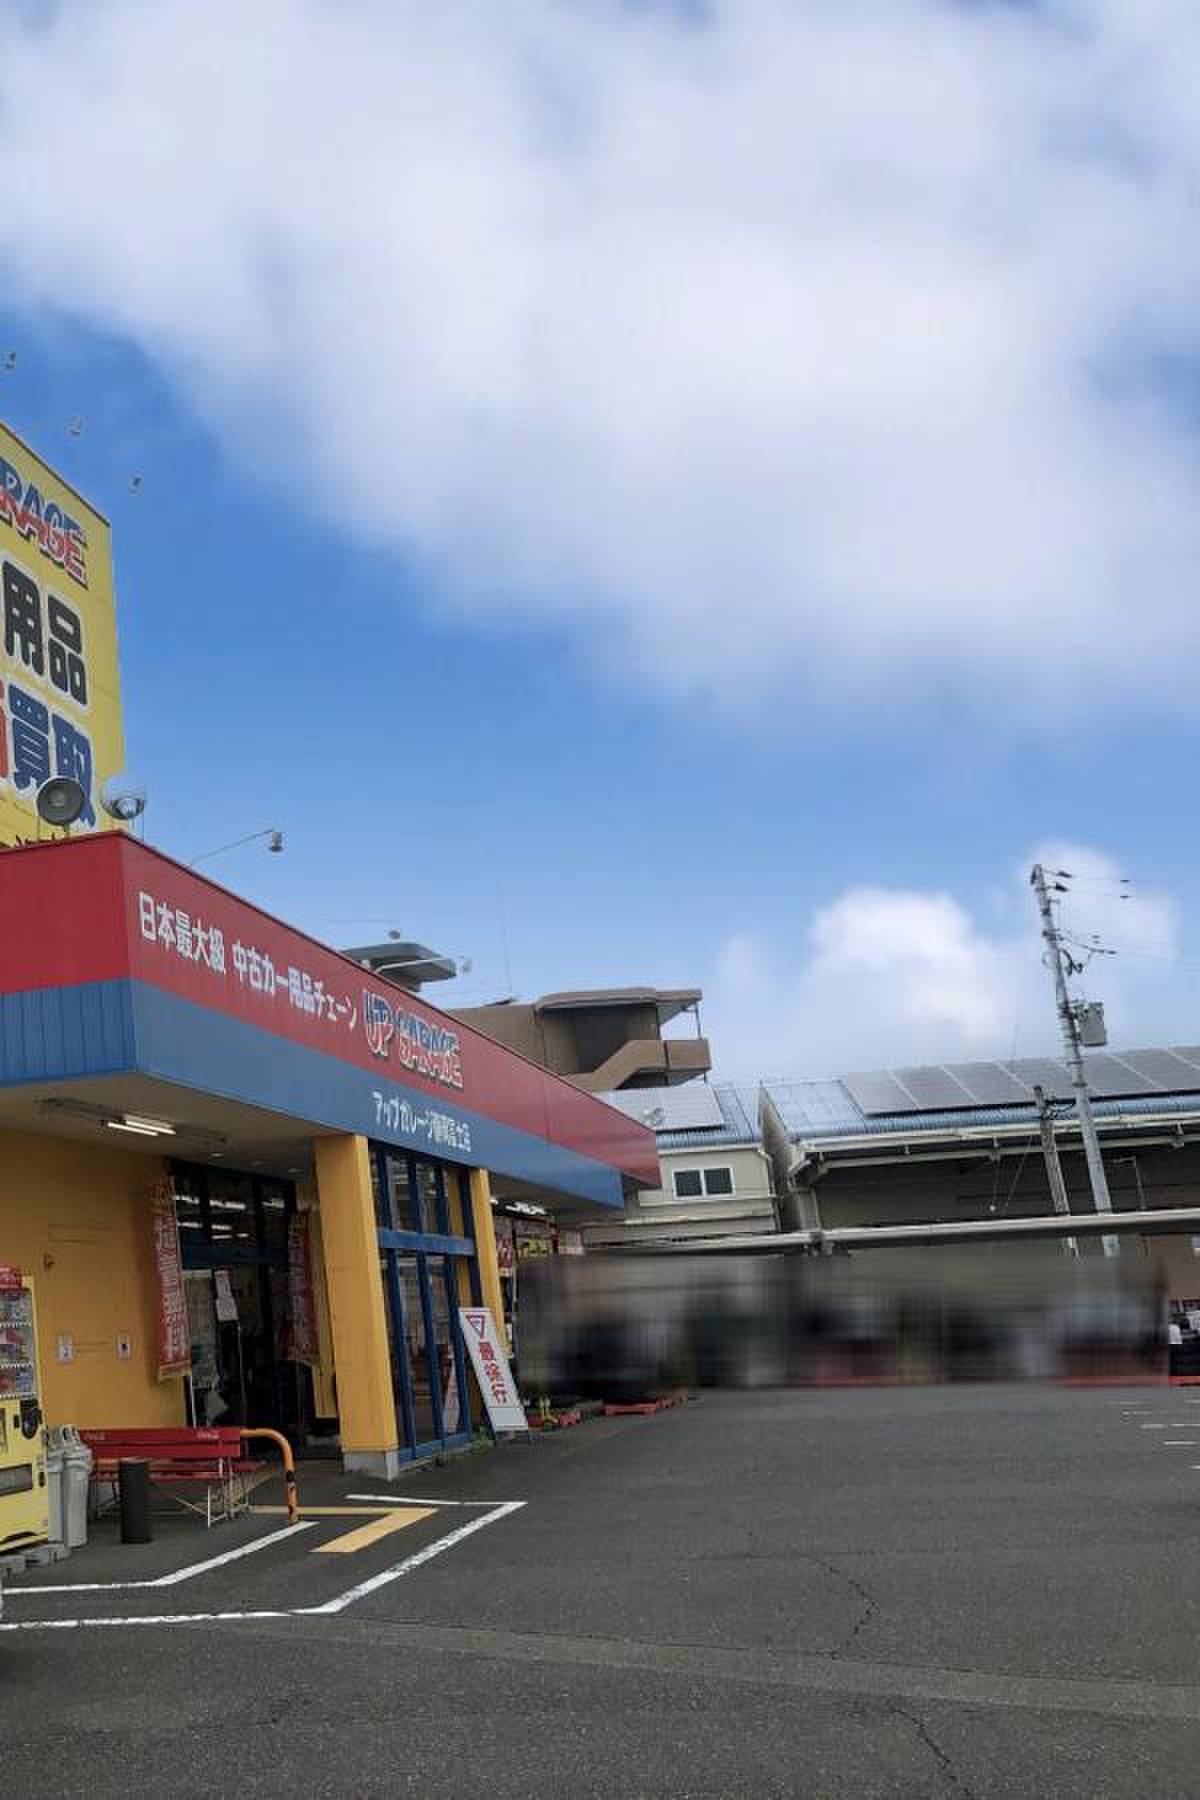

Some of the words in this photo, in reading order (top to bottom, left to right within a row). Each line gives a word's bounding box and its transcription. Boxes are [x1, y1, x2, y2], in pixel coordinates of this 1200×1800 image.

[139, 890, 227, 975] 日本最大級
[362, 988, 395, 1061] UP
